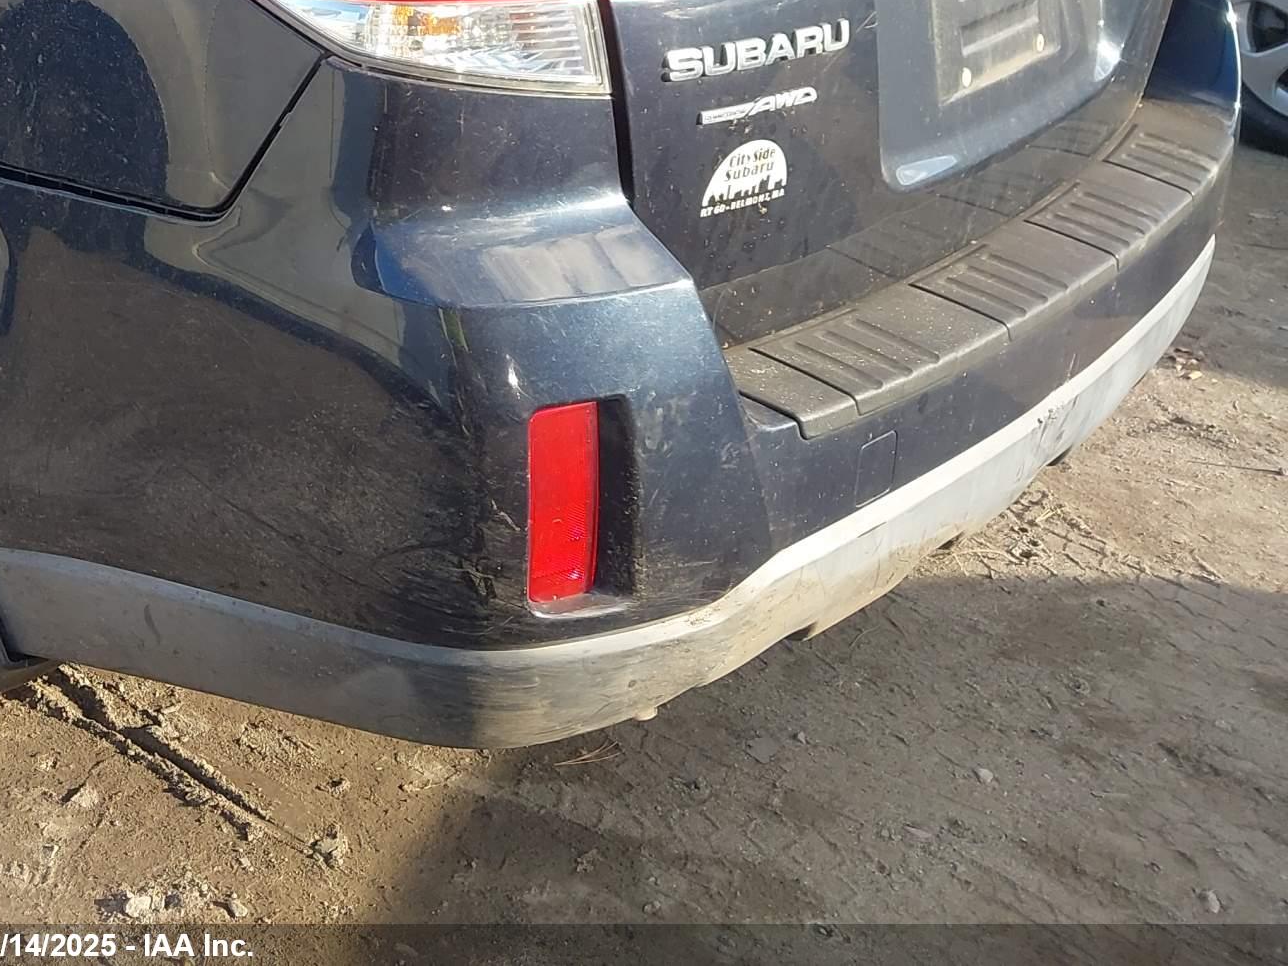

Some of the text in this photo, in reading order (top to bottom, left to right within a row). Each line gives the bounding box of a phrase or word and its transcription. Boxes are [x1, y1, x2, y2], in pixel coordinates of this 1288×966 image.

[664, 18, 851, 82] SUBARU
[748, 86, 818, 116] AWD
[724, 161, 775, 182] Subaru
